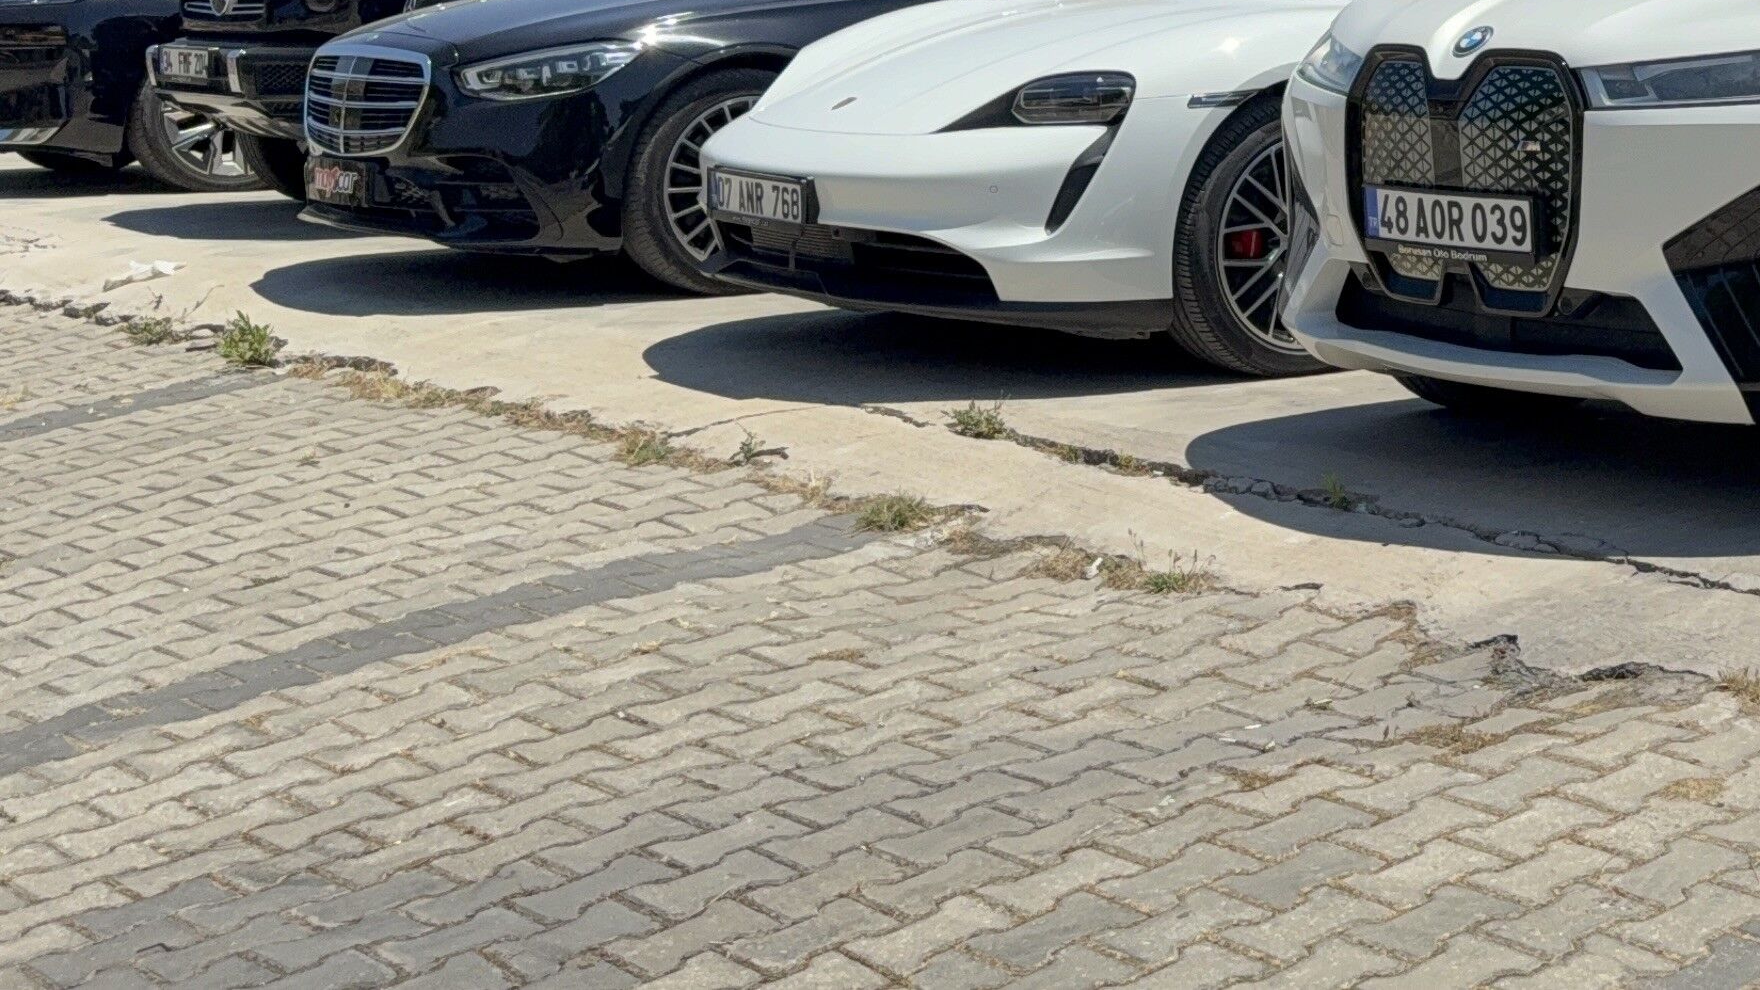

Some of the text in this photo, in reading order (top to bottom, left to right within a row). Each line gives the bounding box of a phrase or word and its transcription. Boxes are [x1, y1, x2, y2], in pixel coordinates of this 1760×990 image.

[718, 176, 800, 220] 07 ANR 768
[1380, 193, 1409, 235] 48
[1415, 197, 1465, 242] AOR
[1471, 202, 1527, 246] 039
